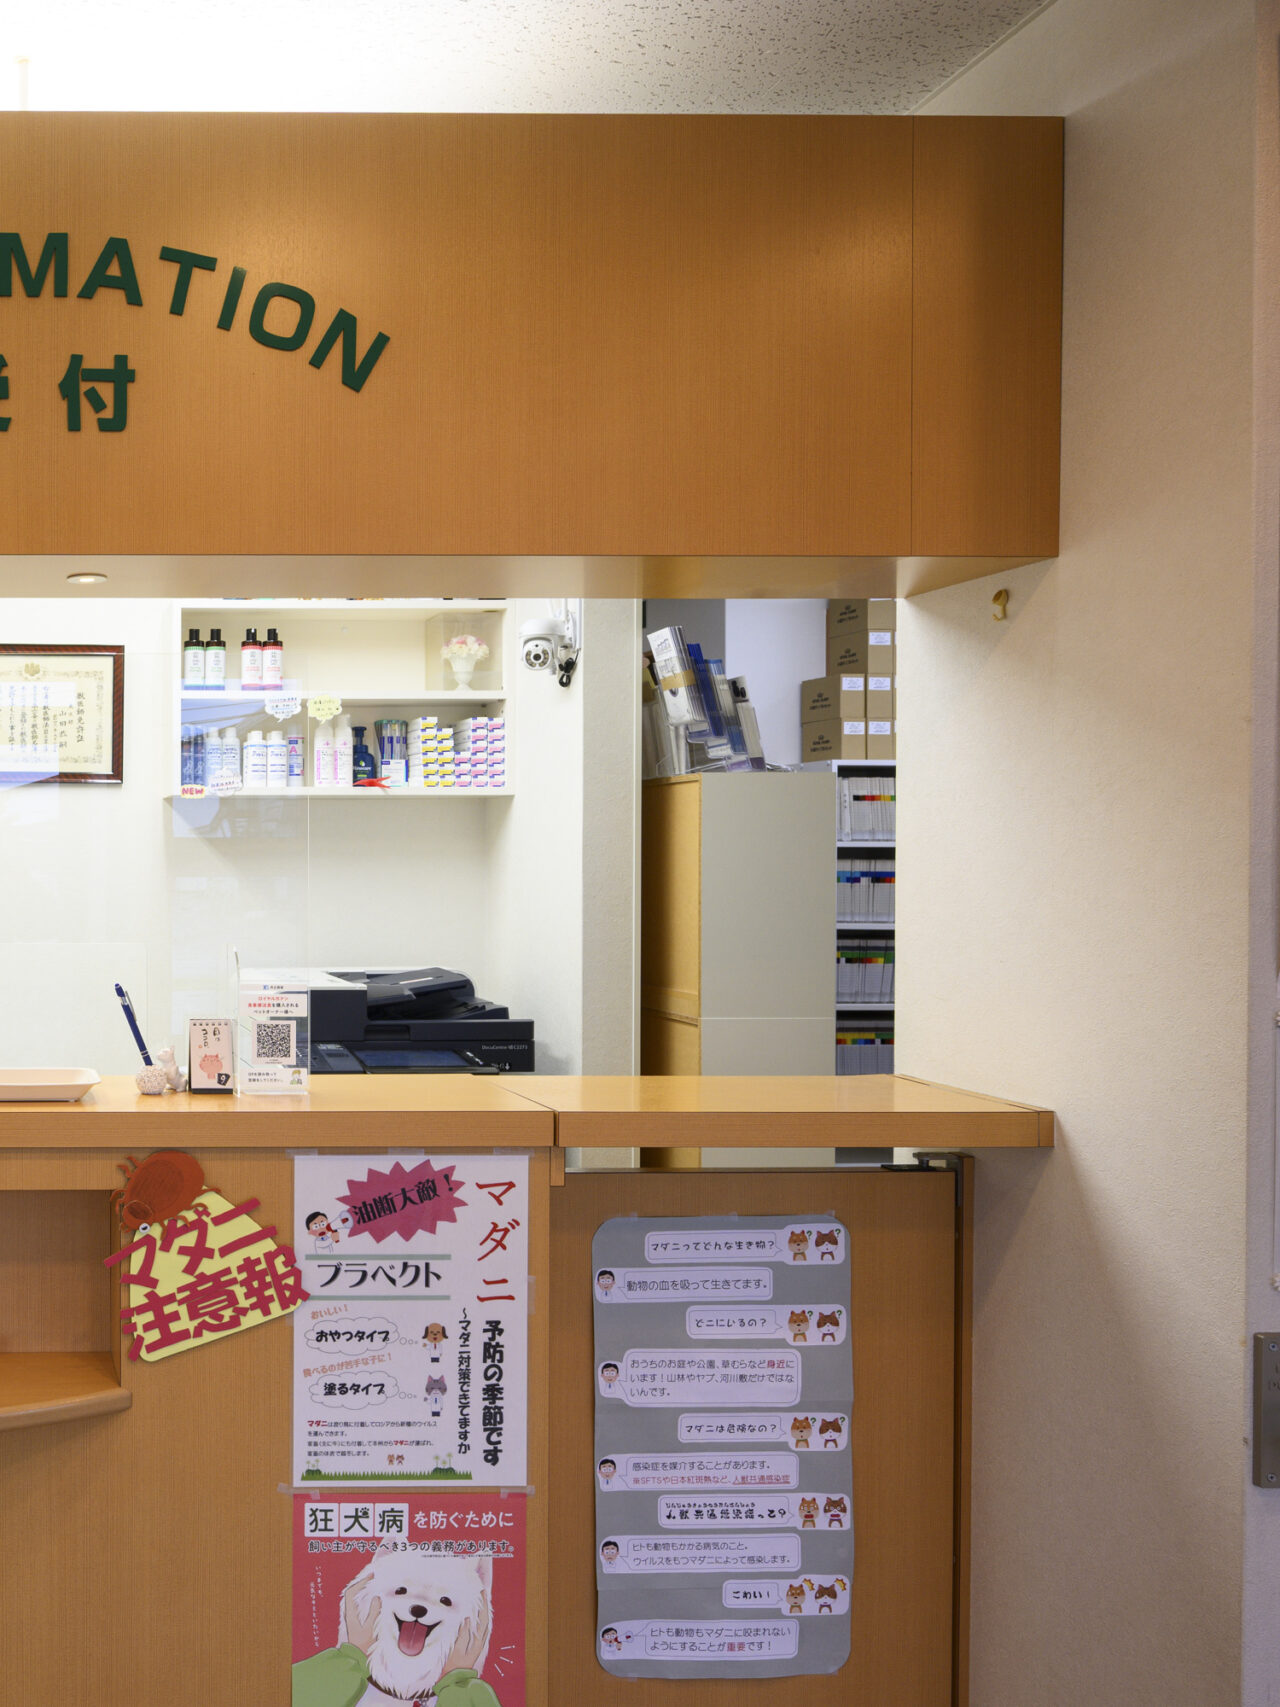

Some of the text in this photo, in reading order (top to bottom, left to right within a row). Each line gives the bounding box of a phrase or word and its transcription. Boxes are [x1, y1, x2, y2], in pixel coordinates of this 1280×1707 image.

[352, 1174, 454, 1226] 油断大敵！
[104, 1197, 278, 1289] マダニ
[651, 1240, 774, 1252] マダニってどんな生き物？
[318, 1261, 442, 1288] ブラベクト
[626, 1279, 768, 1291] 動物の血を吸って生きてます。
[120, 1244, 311, 1362] 注意報
[311, 1304, 350, 1320] おいしい！
[476, 1181, 521, 1466] マダニ 予防の季節です
[695, 1318, 767, 1328] どこにいるの？
[316, 1330, 390, 1343] おやつタイプ
[303, 1352, 392, 1378] 食べるのが苦手な子に！
[630, 1359, 795, 1370] おうちのお庭や公園、草むらなど身近に
[324, 1382, 386, 1396] 塗るタイプ
[630, 1388, 671, 1397] いんです。
[685, 1423, 778, 1434] マダニは危険なの？
[632, 1460, 771, 1472] 感染症を媒介することがあります。
[308, 1507, 514, 1534] 狂犬病 を防ぐために
[308, 1540, 514, 1552] 飼い主が守るべき3つの義務があります。
[632, 1542, 749, 1550] ヒトも動物もかかる病気のこと。
[633, 1554, 791, 1566] ウイルスをもつマダニによって感染します。
[650, 1626, 791, 1638] ヒトも動物もマダニに咬まれない
[650, 1640, 772, 1652] ようにすることが重要です！
